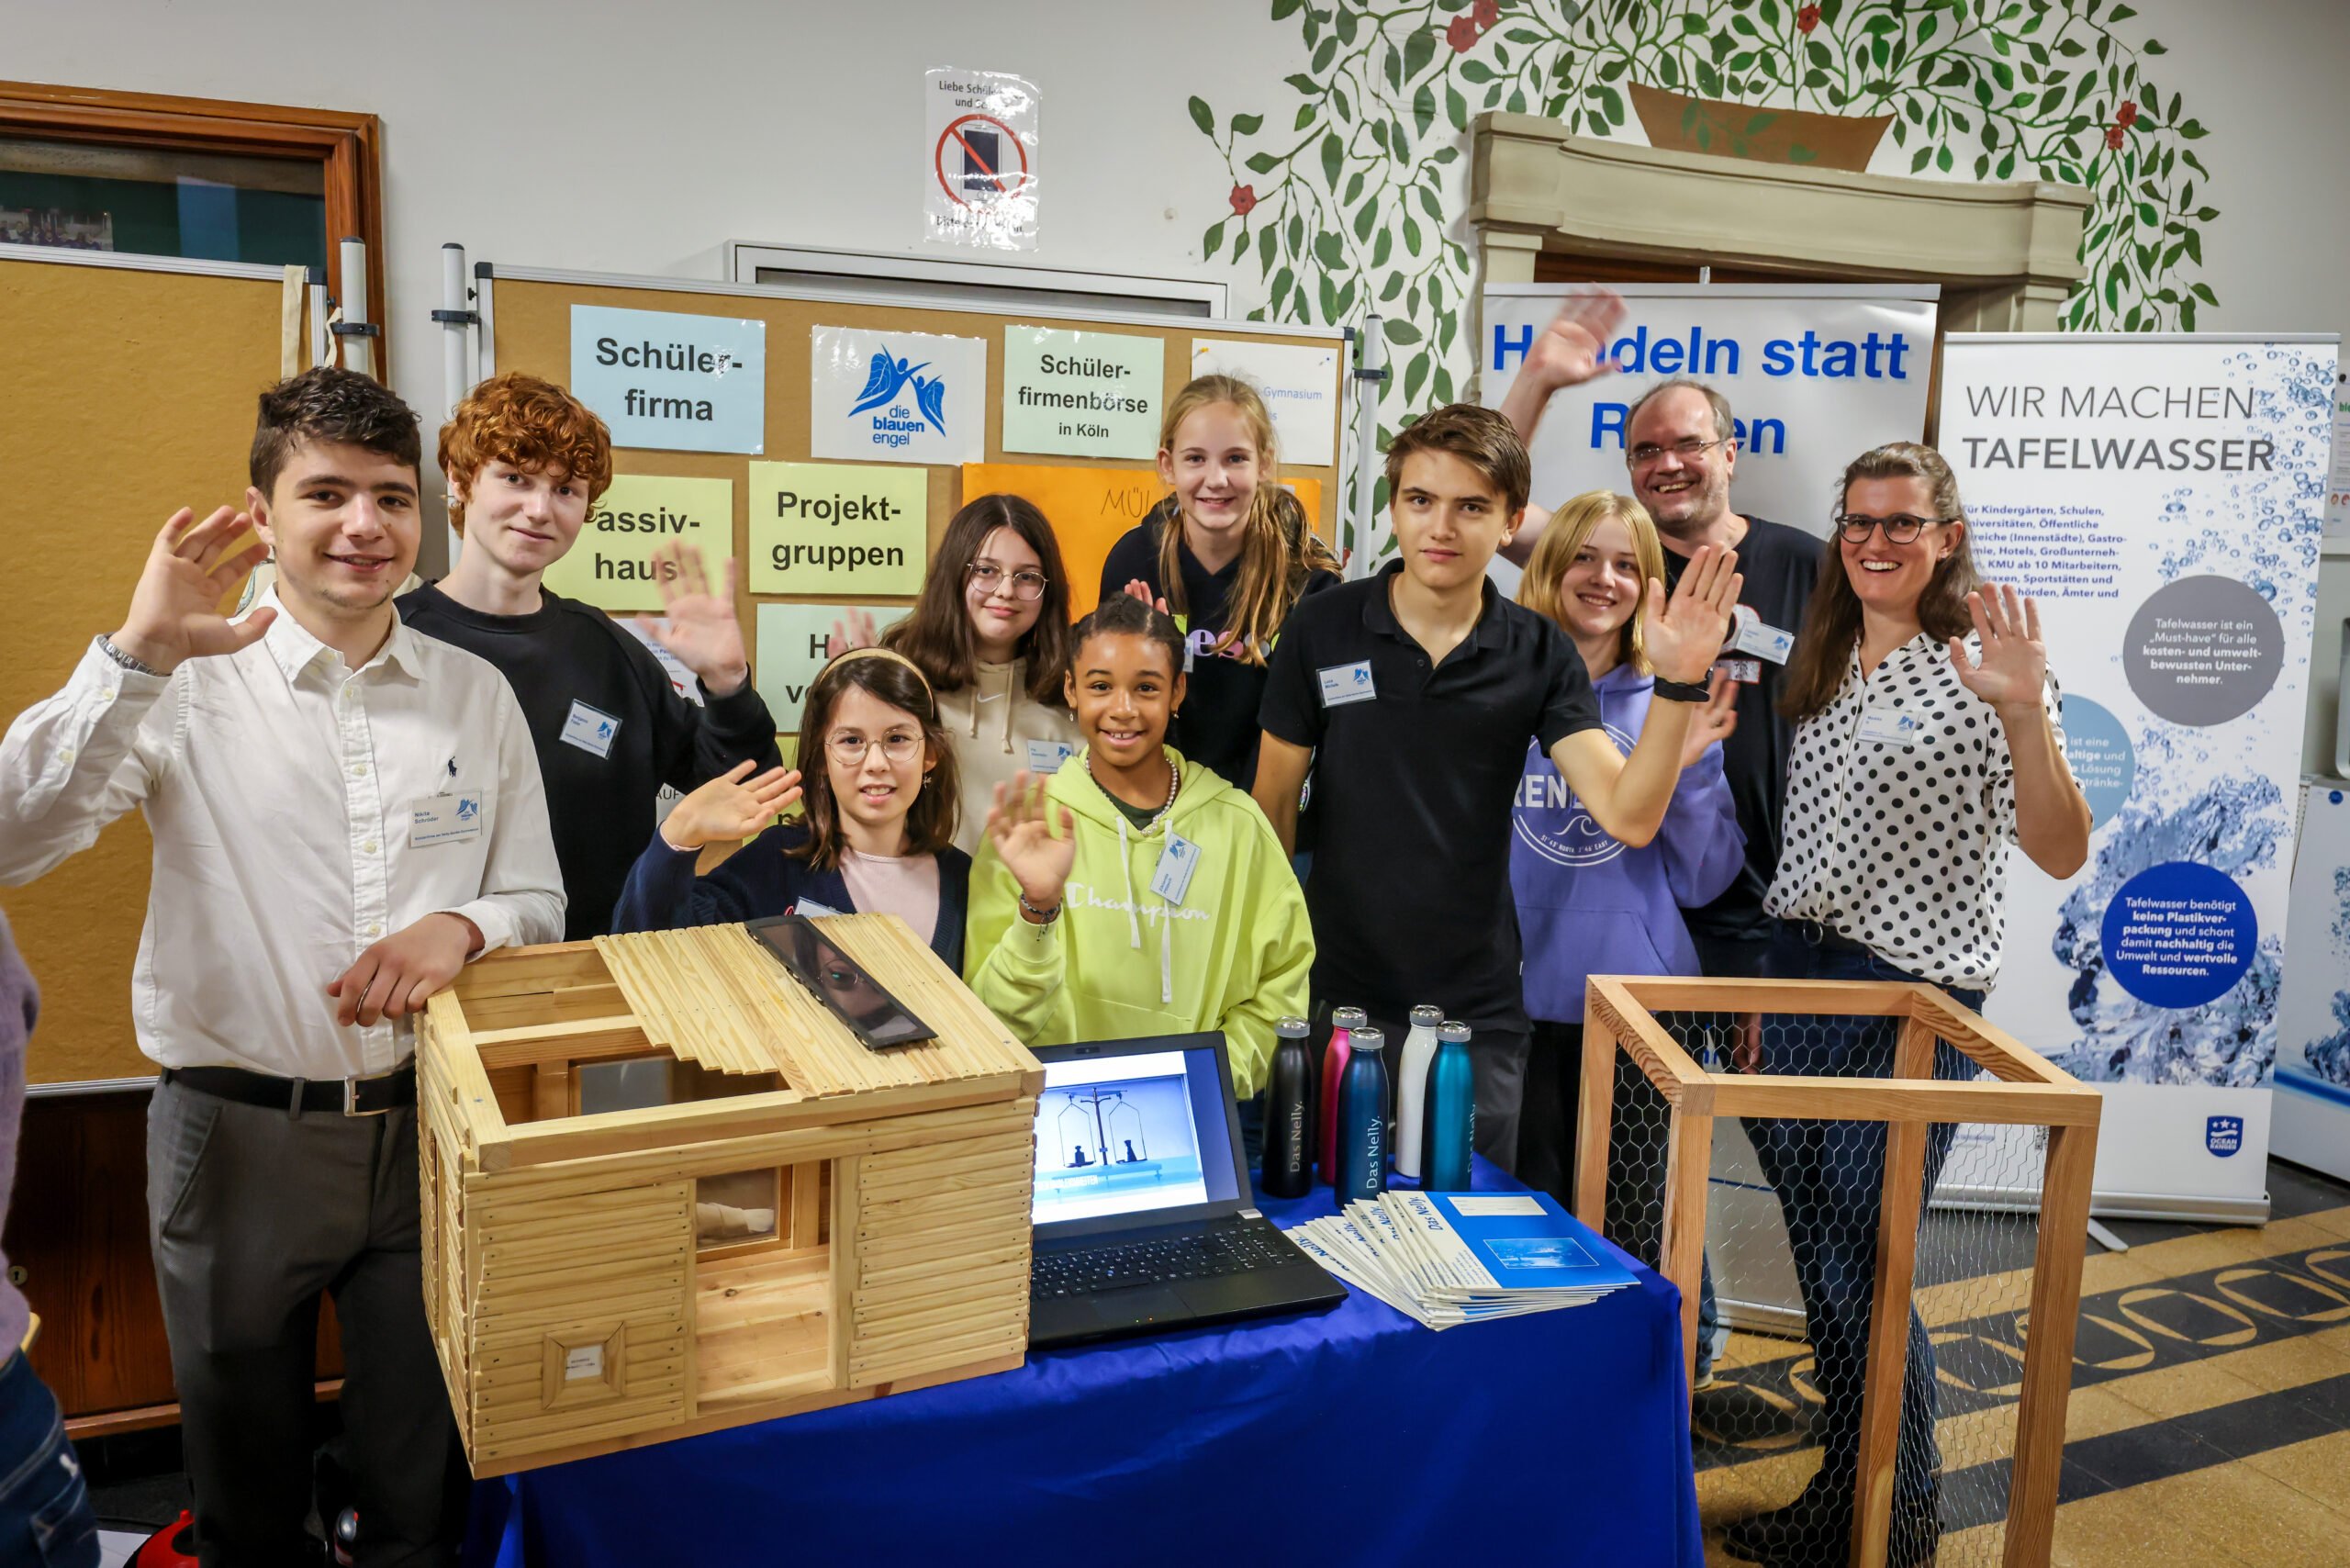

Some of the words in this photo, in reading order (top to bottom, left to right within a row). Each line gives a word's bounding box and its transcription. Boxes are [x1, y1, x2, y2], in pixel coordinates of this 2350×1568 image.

[939, 80, 964, 93] Liebe
[956, 97, 973, 107] und
[596, 337, 743, 374] Schüler-
[1494, 324, 1740, 375] Hdeln
[1762, 330, 1910, 379] statt
[1040, 354, 1131, 379] Schüler-
[625, 389, 714, 421] firma
[1018, 386, 1148, 414] firmenbörse
[1966, 386, 2045, 418] WIR
[2061, 386, 2255, 420] MACHEN
[889, 405, 910, 419] die
[873, 417, 924, 432] blauen
[1058, 423, 1071, 436] in
[1077, 423, 1109, 439] Köln
[873, 431, 910, 448] engel
[1963, 437, 2275, 472] TAFELWASSER
[778, 491, 901, 526] Projekt-
[1982, 505, 2056, 516] Kindergärten,
[2059, 506, 2105, 516] Schulen,
[597, 507, 700, 534] assiv-
[1970, 519, 2036, 529] niversitäten,
[2039, 519, 2099, 529] Öffentliche
[2009, 533, 2085, 543] (Innenstädte),
[2087, 534, 2127, 543] Gastro-
[772, 543, 903, 571] gruppen
[1999, 547, 2037, 557] Hotels,
[2040, 547, 2120, 557] Großunterneh-
[596, 553, 677, 581] haus
[1988, 560, 2015, 569] KMU
[2018, 561, 2031, 569] ab
[2035, 561, 2048, 569] 10
[2052, 561, 2121, 571] Mitarbeitern,
[2023, 574, 2089, 584] Sportstätten
[2092, 575, 2113, 584] und
[2063, 588, 2094, 598] Ämter
[2097, 589, 2119, 598] und
[2155, 618, 2218, 630] Tafelwasser
[2221, 620, 2233, 630] ist
[2235, 621, 2254, 631] ein
[2219, 633, 2234, 644] für
[2236, 633, 2257, 644] alle
[2143, 645, 2186, 656] kosten-
[2188, 646, 2210, 656] und
[2213, 647, 2262, 657] umwelt-
[2150, 659, 2212, 671] bewussten
[2215, 661, 2252, 671] Unter-
[2177, 674, 2223, 685] nehmer.
[2070, 736, 2082, 746] ist
[2085, 737, 2109, 747] eine
[2104, 751, 2126, 761] und
[2082, 764, 2121, 777] Lösung
[2084, 778, 2123, 788] tränke-
[2125, 897, 2188, 910] Tafelwasser
[2190, 898, 2236, 913] benötigt
[2132, 911, 2165, 922] keine
[2166, 912, 2227, 924] Plastikver-
[2122, 924, 2172, 937] packung
[2175, 926, 2196, 936] und
[2199, 926, 2234, 937] schont
[2121, 937, 2152, 948] damit
[2154, 939, 2214, 952] nachhaltig
[2217, 940, 2234, 950] die
[2116, 950, 2157, 962] Umwelt
[2160, 952, 2181, 962] und
[2183, 953, 2238, 964] wertvolle
[2142, 964, 2210, 976] Ressourcen.
[1291, 1101, 1305, 1141] Nelly.
[1368, 1115, 1382, 1158] Nelly.
[1290, 1145, 1301, 1172] Das
[1366, 1160, 1378, 1189] Das
[1408, 1196, 1432, 1215] Nelly.
[1425, 1216, 1444, 1231] Das
